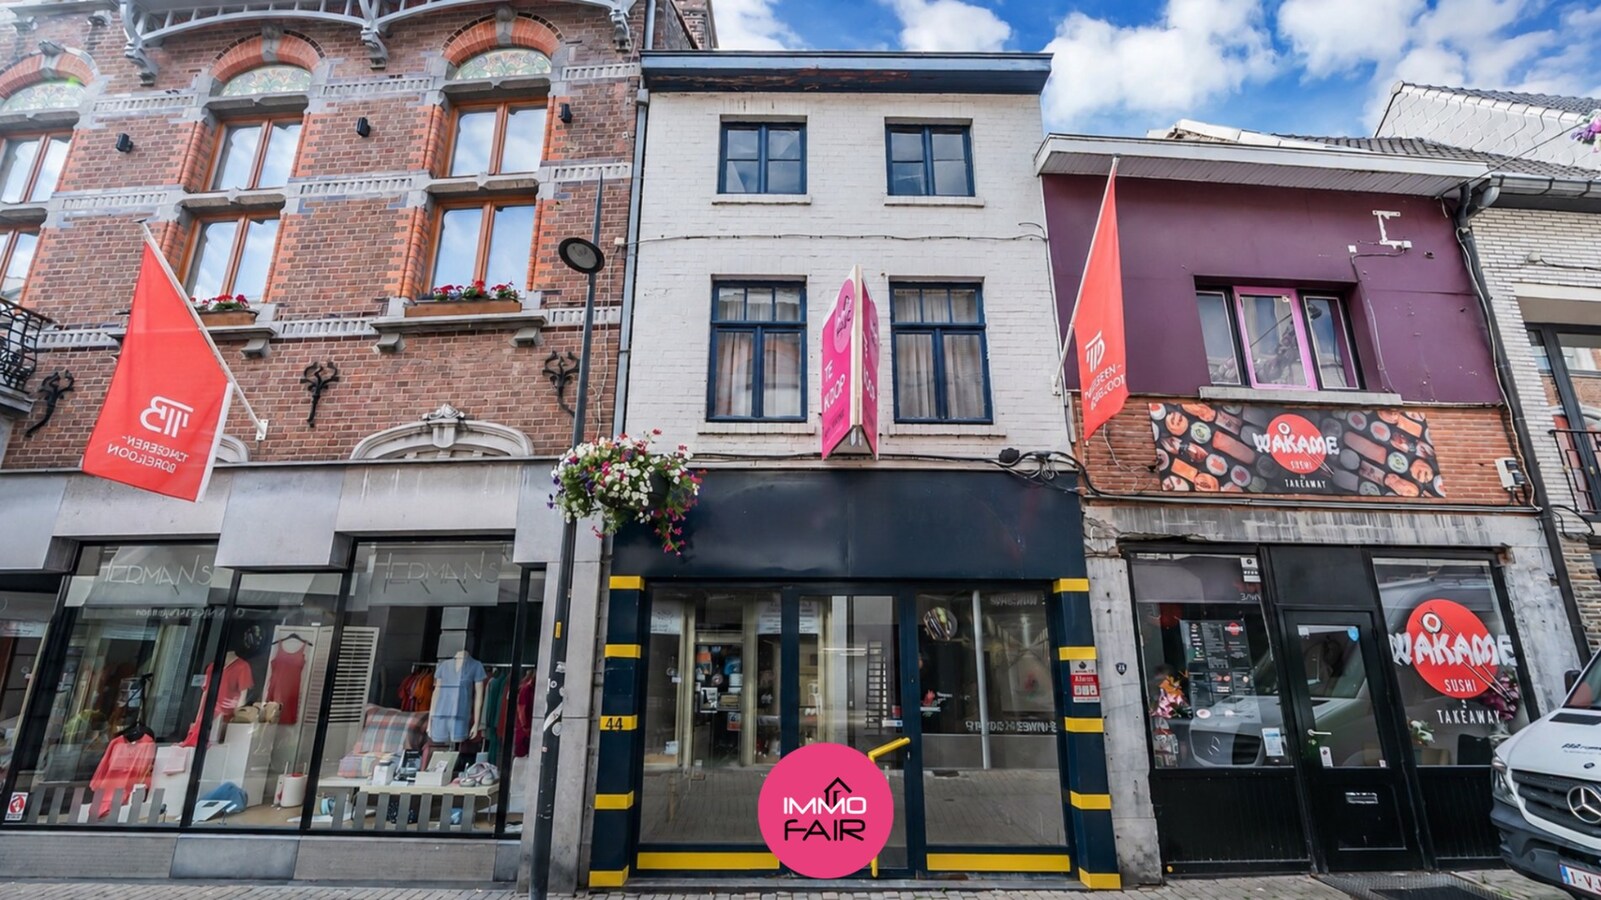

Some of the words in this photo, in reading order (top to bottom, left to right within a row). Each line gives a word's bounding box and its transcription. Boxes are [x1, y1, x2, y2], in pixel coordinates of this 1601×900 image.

[1252, 433, 1340, 455] WAKAME
[100, 554, 213, 595] HERMANS
[375, 551, 499, 594] HERMANS
[1388, 632, 1518, 667] WAKAME
[1444, 679, 1477, 692] SUSHI
[605, 717, 623, 731] 44
[1436, 709, 1500, 724] TAKEAWAY
